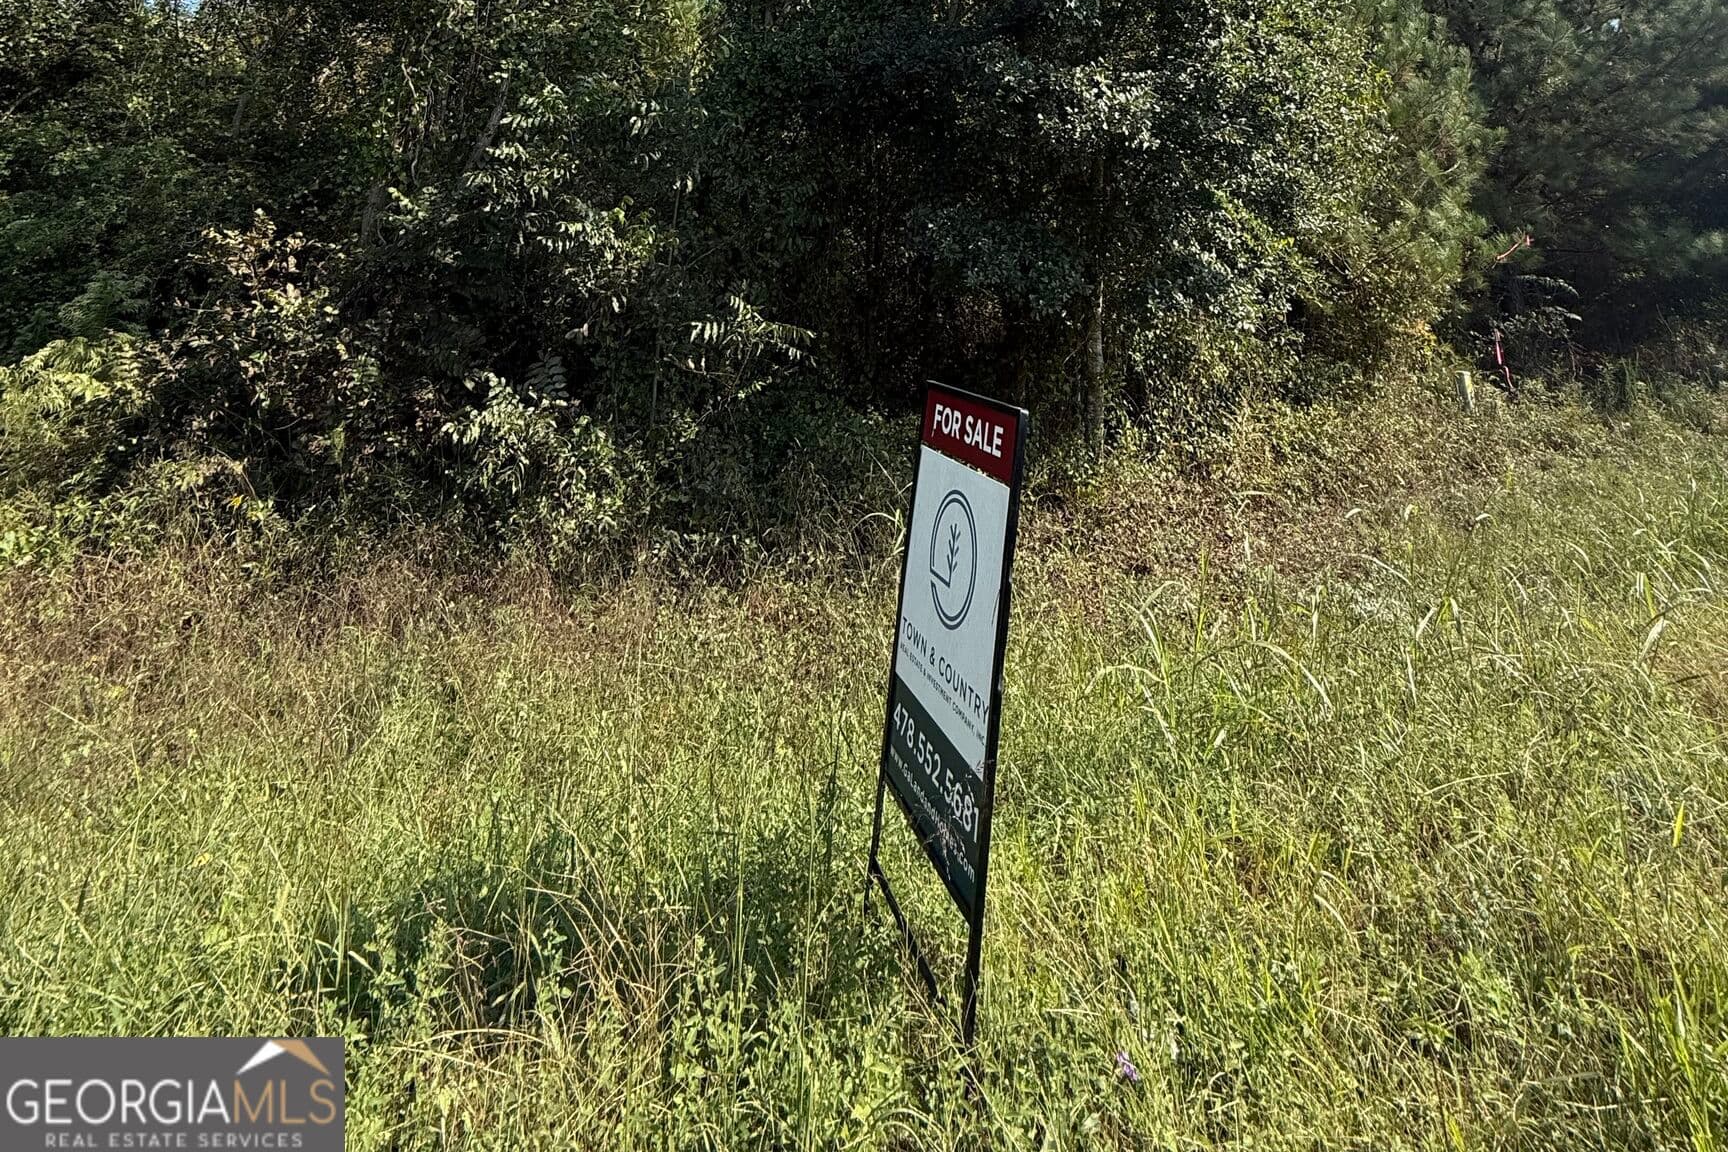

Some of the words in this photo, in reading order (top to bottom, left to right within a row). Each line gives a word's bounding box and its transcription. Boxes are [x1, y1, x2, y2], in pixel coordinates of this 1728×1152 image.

[933, 403, 962, 440] FOR
[964, 415, 1004, 458] SALE
[902, 616, 928, 658] TOWN
[929, 646, 936, 667] &
[938, 656, 989, 725] COUNTRY
[893, 702, 980, 844] 478.552.5681
